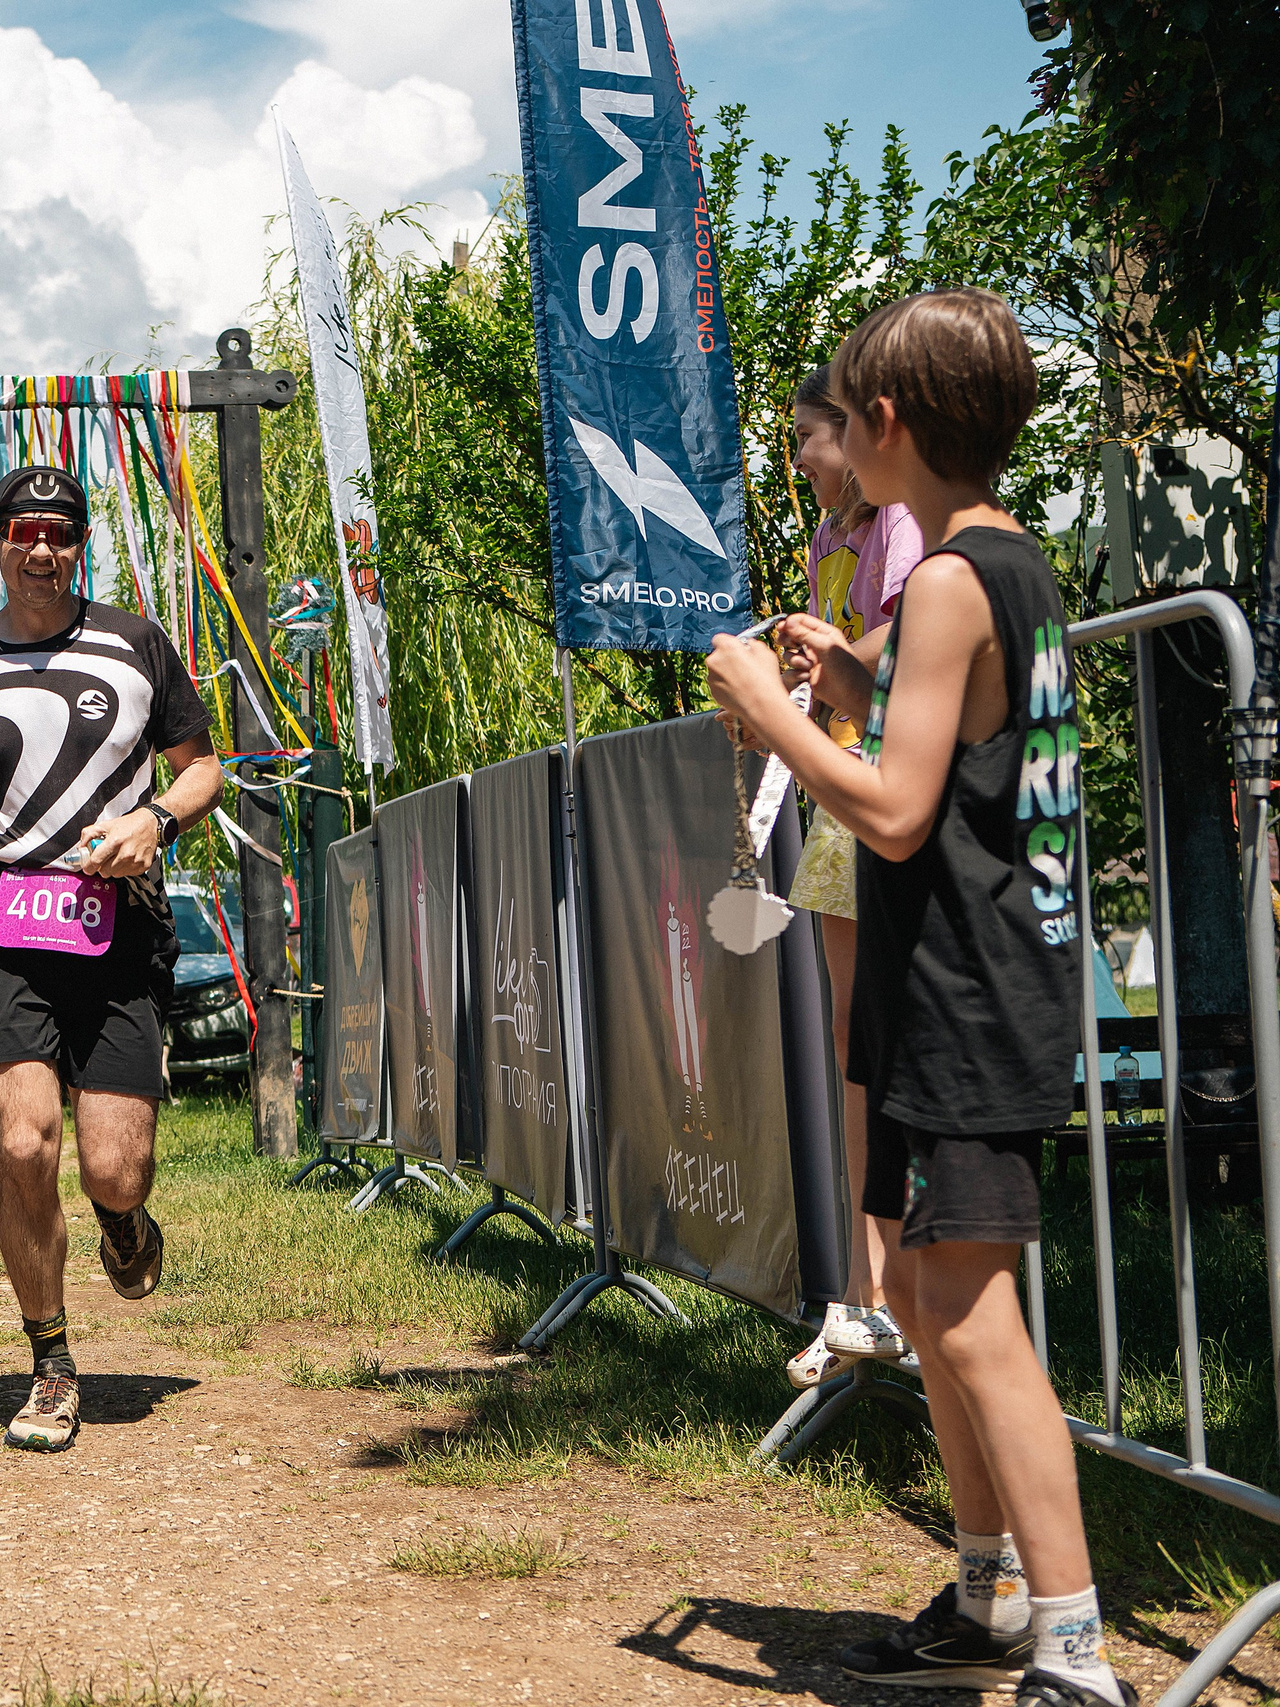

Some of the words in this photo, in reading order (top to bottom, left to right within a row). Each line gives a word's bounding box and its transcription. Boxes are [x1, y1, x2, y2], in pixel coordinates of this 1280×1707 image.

[680, 101, 701, 173] ТВОЯ
[694, 196, 715, 353] СМЕЛОСТЬ
[580, 581, 734, 613] SMELO.PRO
[6, 888, 102, 928] 4008
[340, 1039, 373, 1081] ДВИЖ
